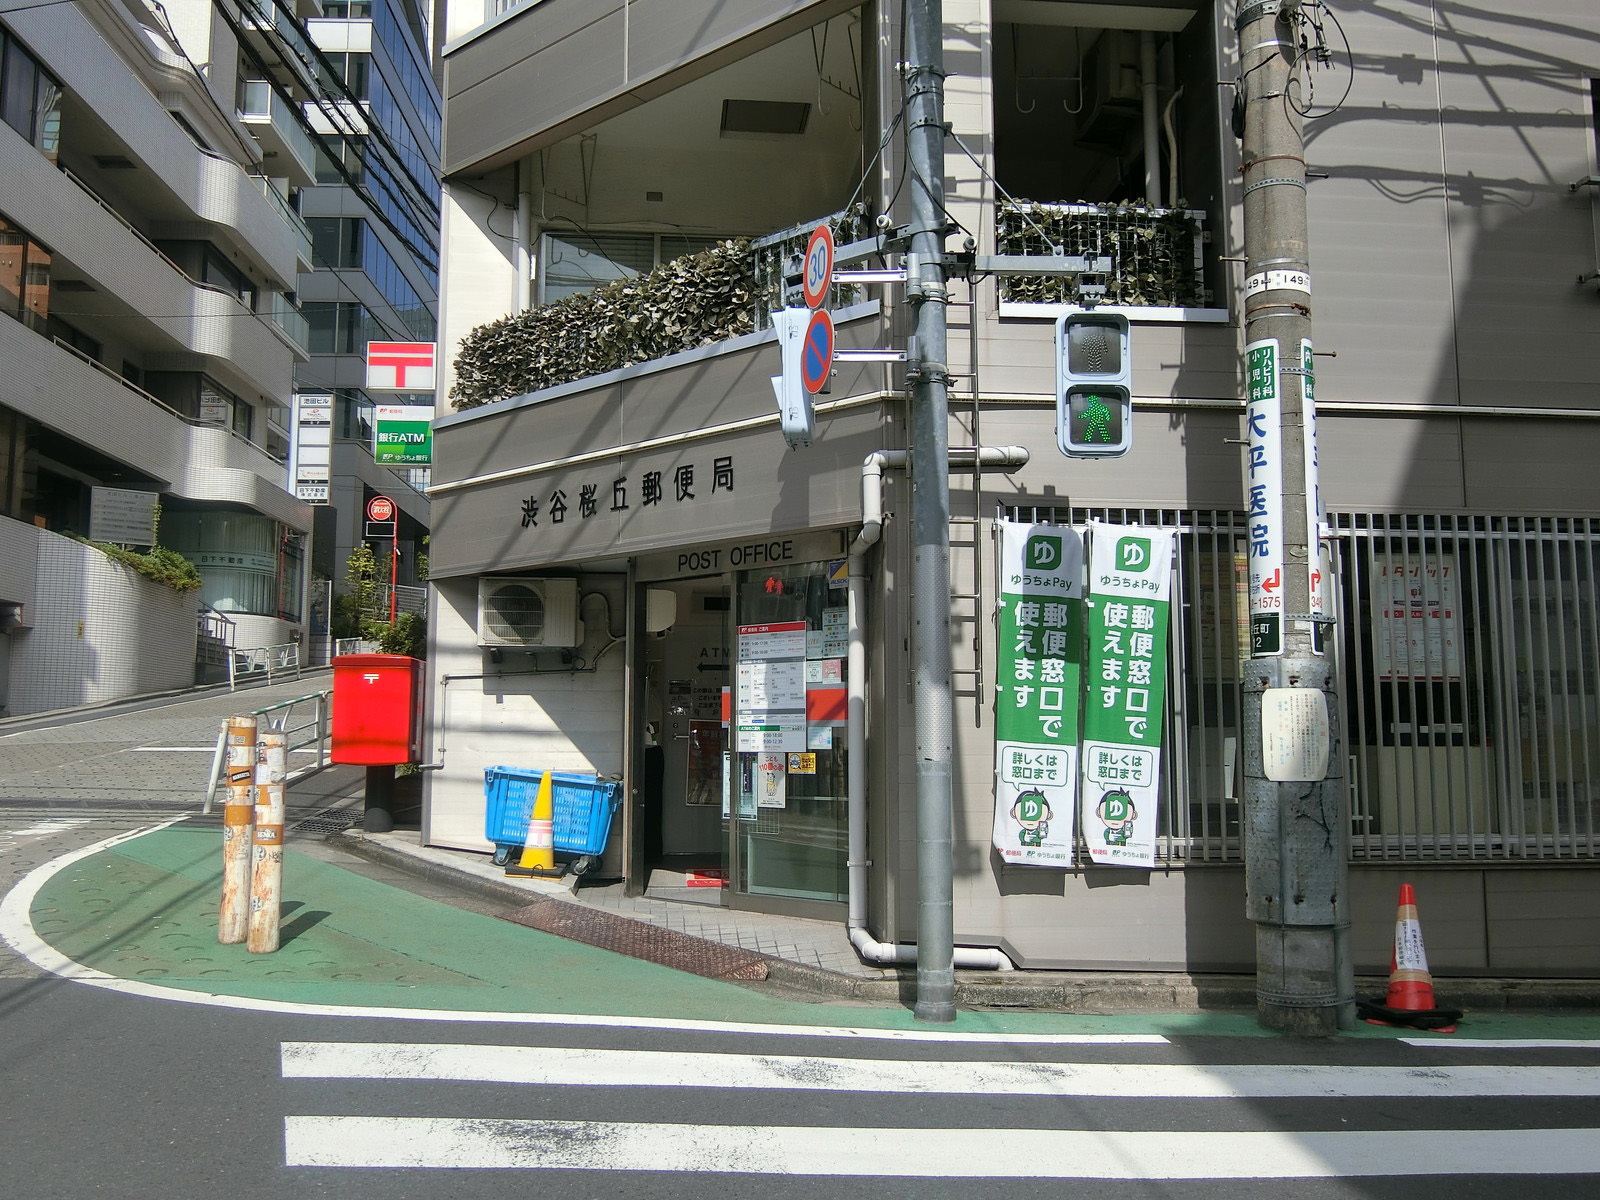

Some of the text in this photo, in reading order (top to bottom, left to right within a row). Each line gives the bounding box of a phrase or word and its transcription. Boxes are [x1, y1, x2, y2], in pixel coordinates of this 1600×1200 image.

[810, 245, 826, 287] 30
[1284, 274, 1304, 285] 149
[1251, 350, 1261, 400] 小児科
[1262, 348, 1274, 397] リハビリ科
[378, 432, 425, 443] 銀行ATM
[521, 455, 734, 528] 渋谷桜丘郵便局
[678, 540, 793, 572] POST OFFICE
[1034, 541, 1056, 565] ゆ
[1123, 542, 1145, 566] ゆ
[1010, 574, 1073, 592] ゆうちょPay
[1099, 575, 1161, 593] ゆうちょPay
[1013, 601, 1041, 708] 使えます
[1100, 602, 1129, 708] 使えます
[1039, 602, 1068, 738] 郵便窓口で
[1124, 604, 1155, 739] 郵便窓口で
[1012, 751, 1058, 767] 詳しくは
[1098, 751, 1143, 767] 詳しくは
[1011, 766, 1058, 781] 窓口まで
[1097, 766, 1142, 781] 窓口まで
[1024, 799, 1039, 817] ゆ
[1109, 799, 1124, 817] ゆ
[1005, 849, 1022, 857] 郵便局
[1092, 848, 1108, 856] 郵便局
